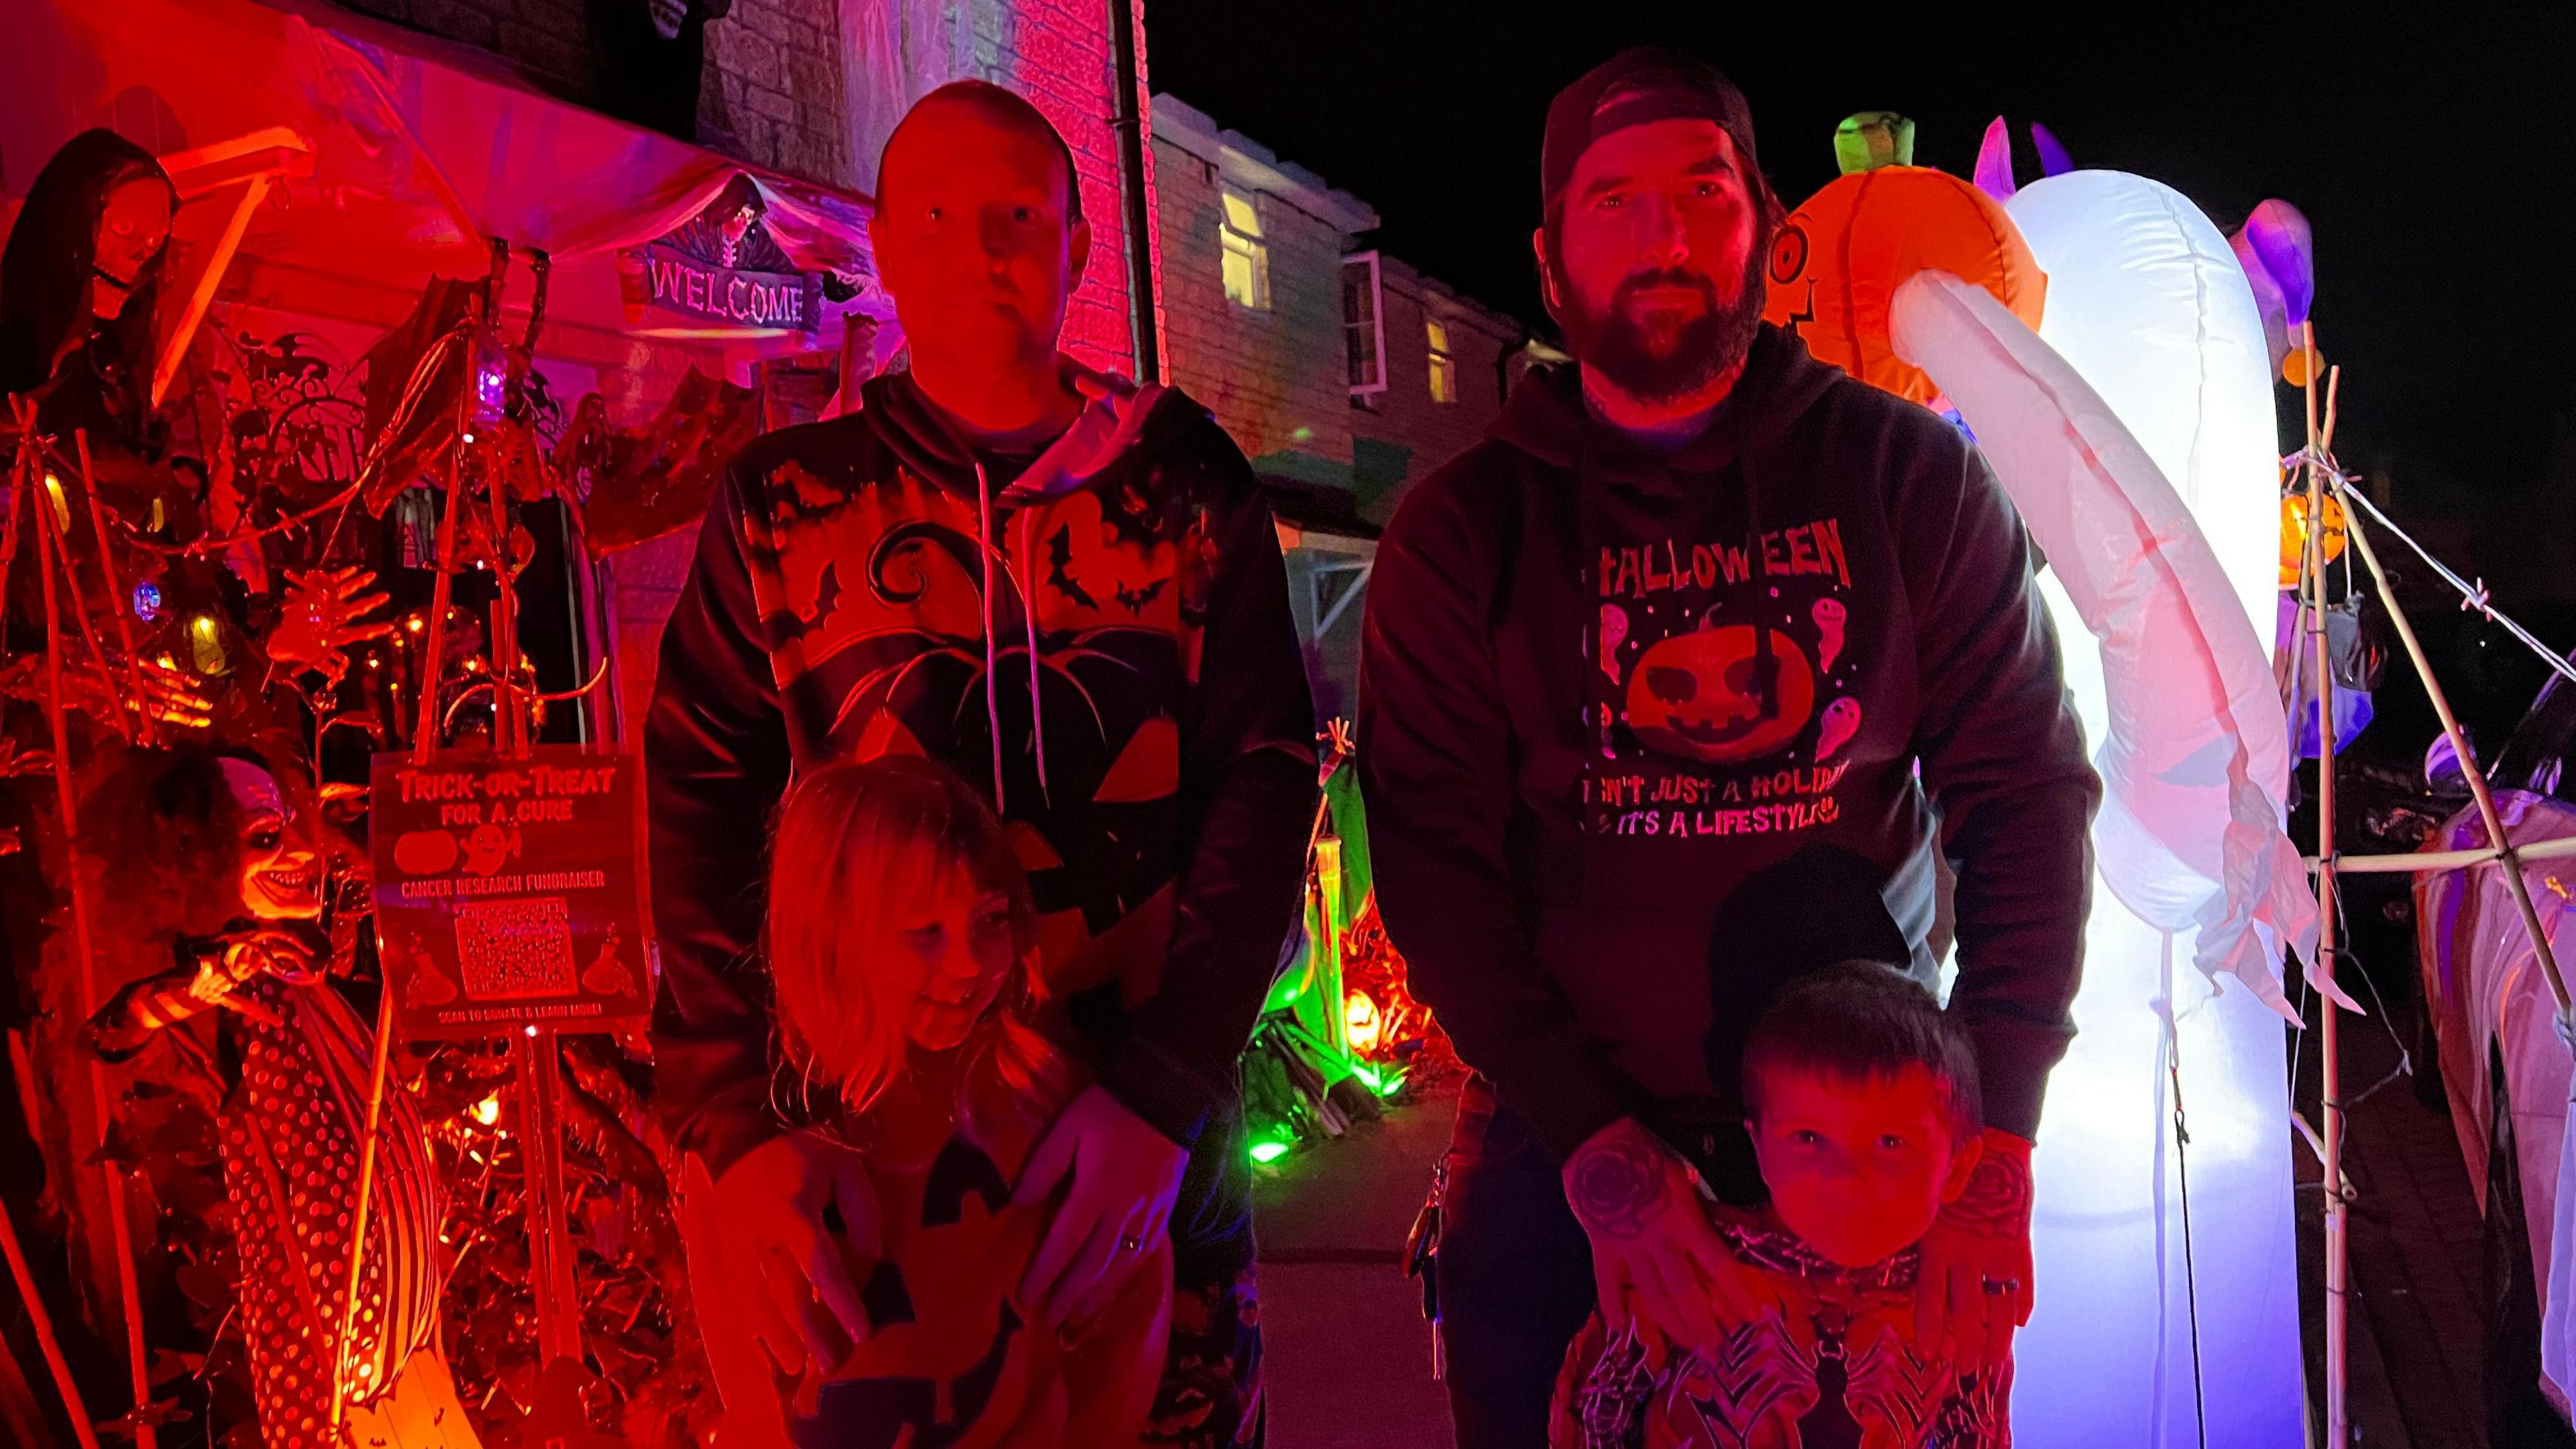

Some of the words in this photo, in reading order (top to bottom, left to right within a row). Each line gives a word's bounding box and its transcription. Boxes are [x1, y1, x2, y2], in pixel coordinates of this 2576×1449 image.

[649, 259, 803, 323] WELCOME
[1651, 773, 1715, 804] JUST
[1723, 780, 1742, 802] A
[1751, 759, 1850, 799] HOLID
[441, 803, 481, 826] FOR
[492, 802, 507, 823] A
[517, 800, 574, 822] CURE
[1669, 812, 1687, 837] A
[402, 879, 451, 898] CANCER
[456, 875, 521, 896] RESEARCH
[527, 871, 604, 891] FUNDRAISER
[439, 1010, 466, 1024] SCAN
[469, 1010, 482, 1022] TO
[484, 1008, 523, 1021] DONATE
[535, 1005, 568, 1018] LEARN
